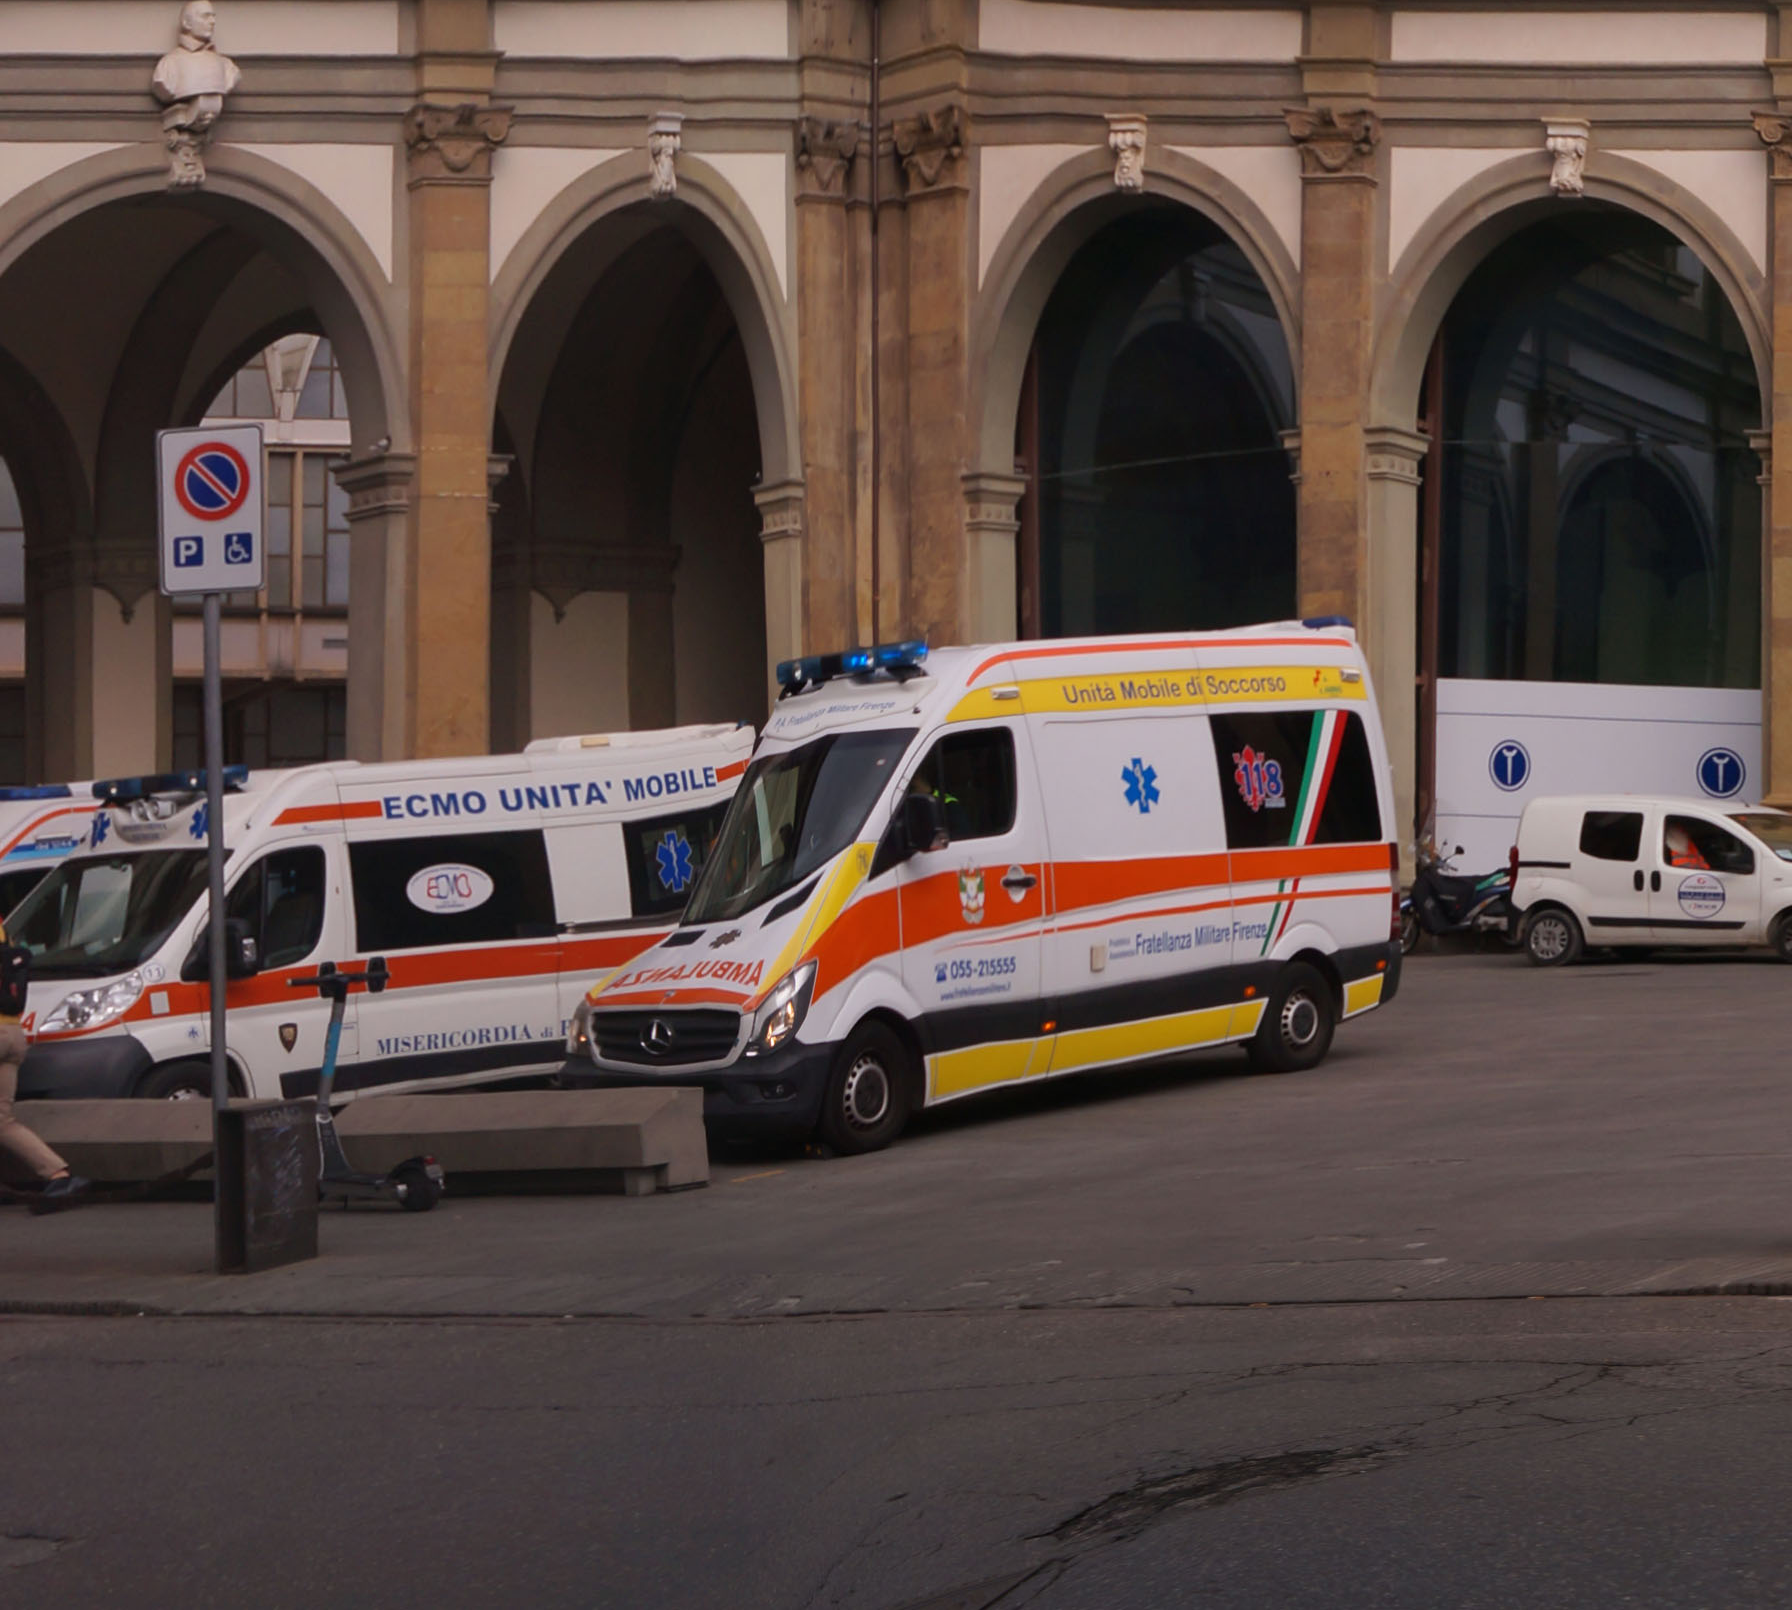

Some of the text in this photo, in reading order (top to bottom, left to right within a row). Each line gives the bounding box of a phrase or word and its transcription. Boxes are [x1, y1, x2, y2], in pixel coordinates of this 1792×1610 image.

[179, 540, 198, 565] P
[1062, 675, 1286, 703] Unità Mobile di Soccorso
[383, 767, 716, 819] ECMO UNITA' MOBILE
[1240, 762, 1282, 796] 118
[1135, 922, 1267, 956] Fratellanza Militare Firenze
[376, 1024, 532, 1056] MISERICORDIA
[541, 1026, 553, 1038] di
